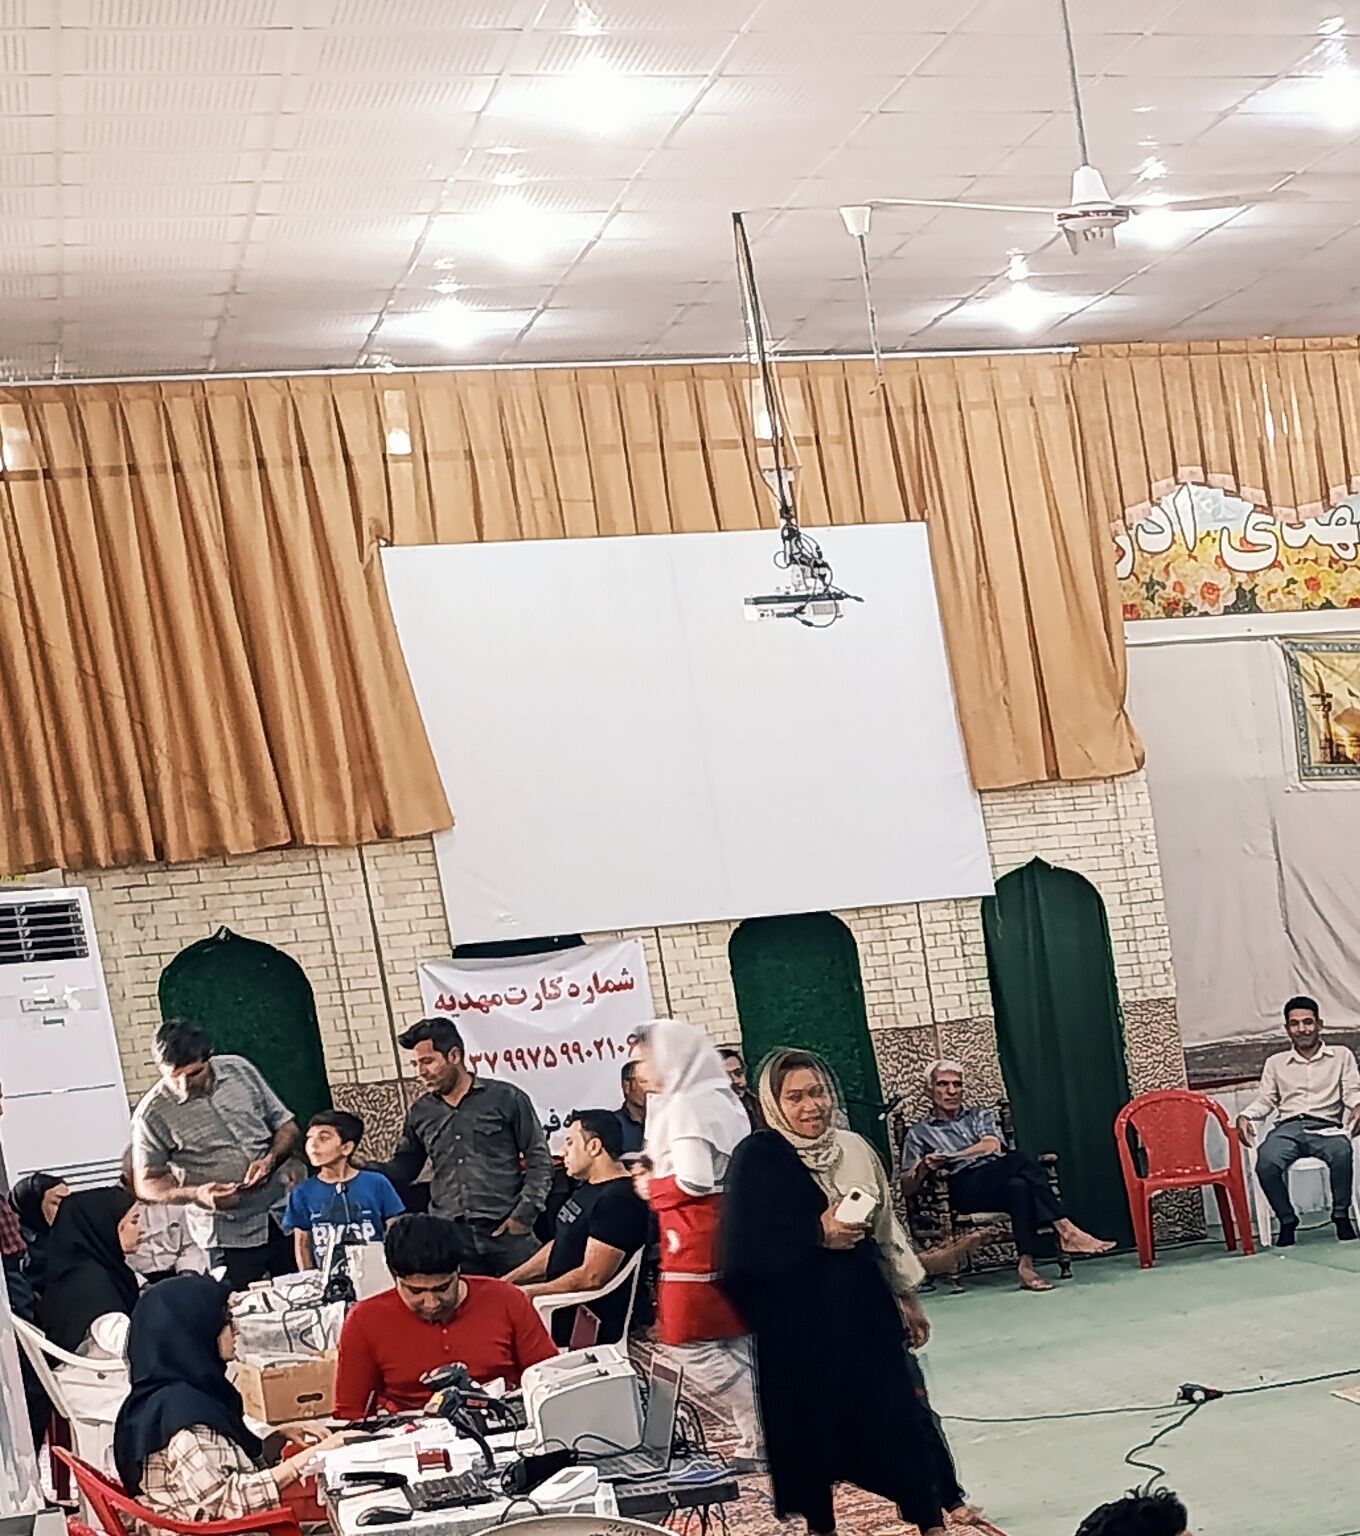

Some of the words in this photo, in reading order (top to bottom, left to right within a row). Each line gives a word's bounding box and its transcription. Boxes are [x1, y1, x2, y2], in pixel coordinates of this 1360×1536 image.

[504, 976, 564, 1012] کارت
[567, 967, 635, 1005] شماره
[434, 992, 503, 1018] مهدیه
